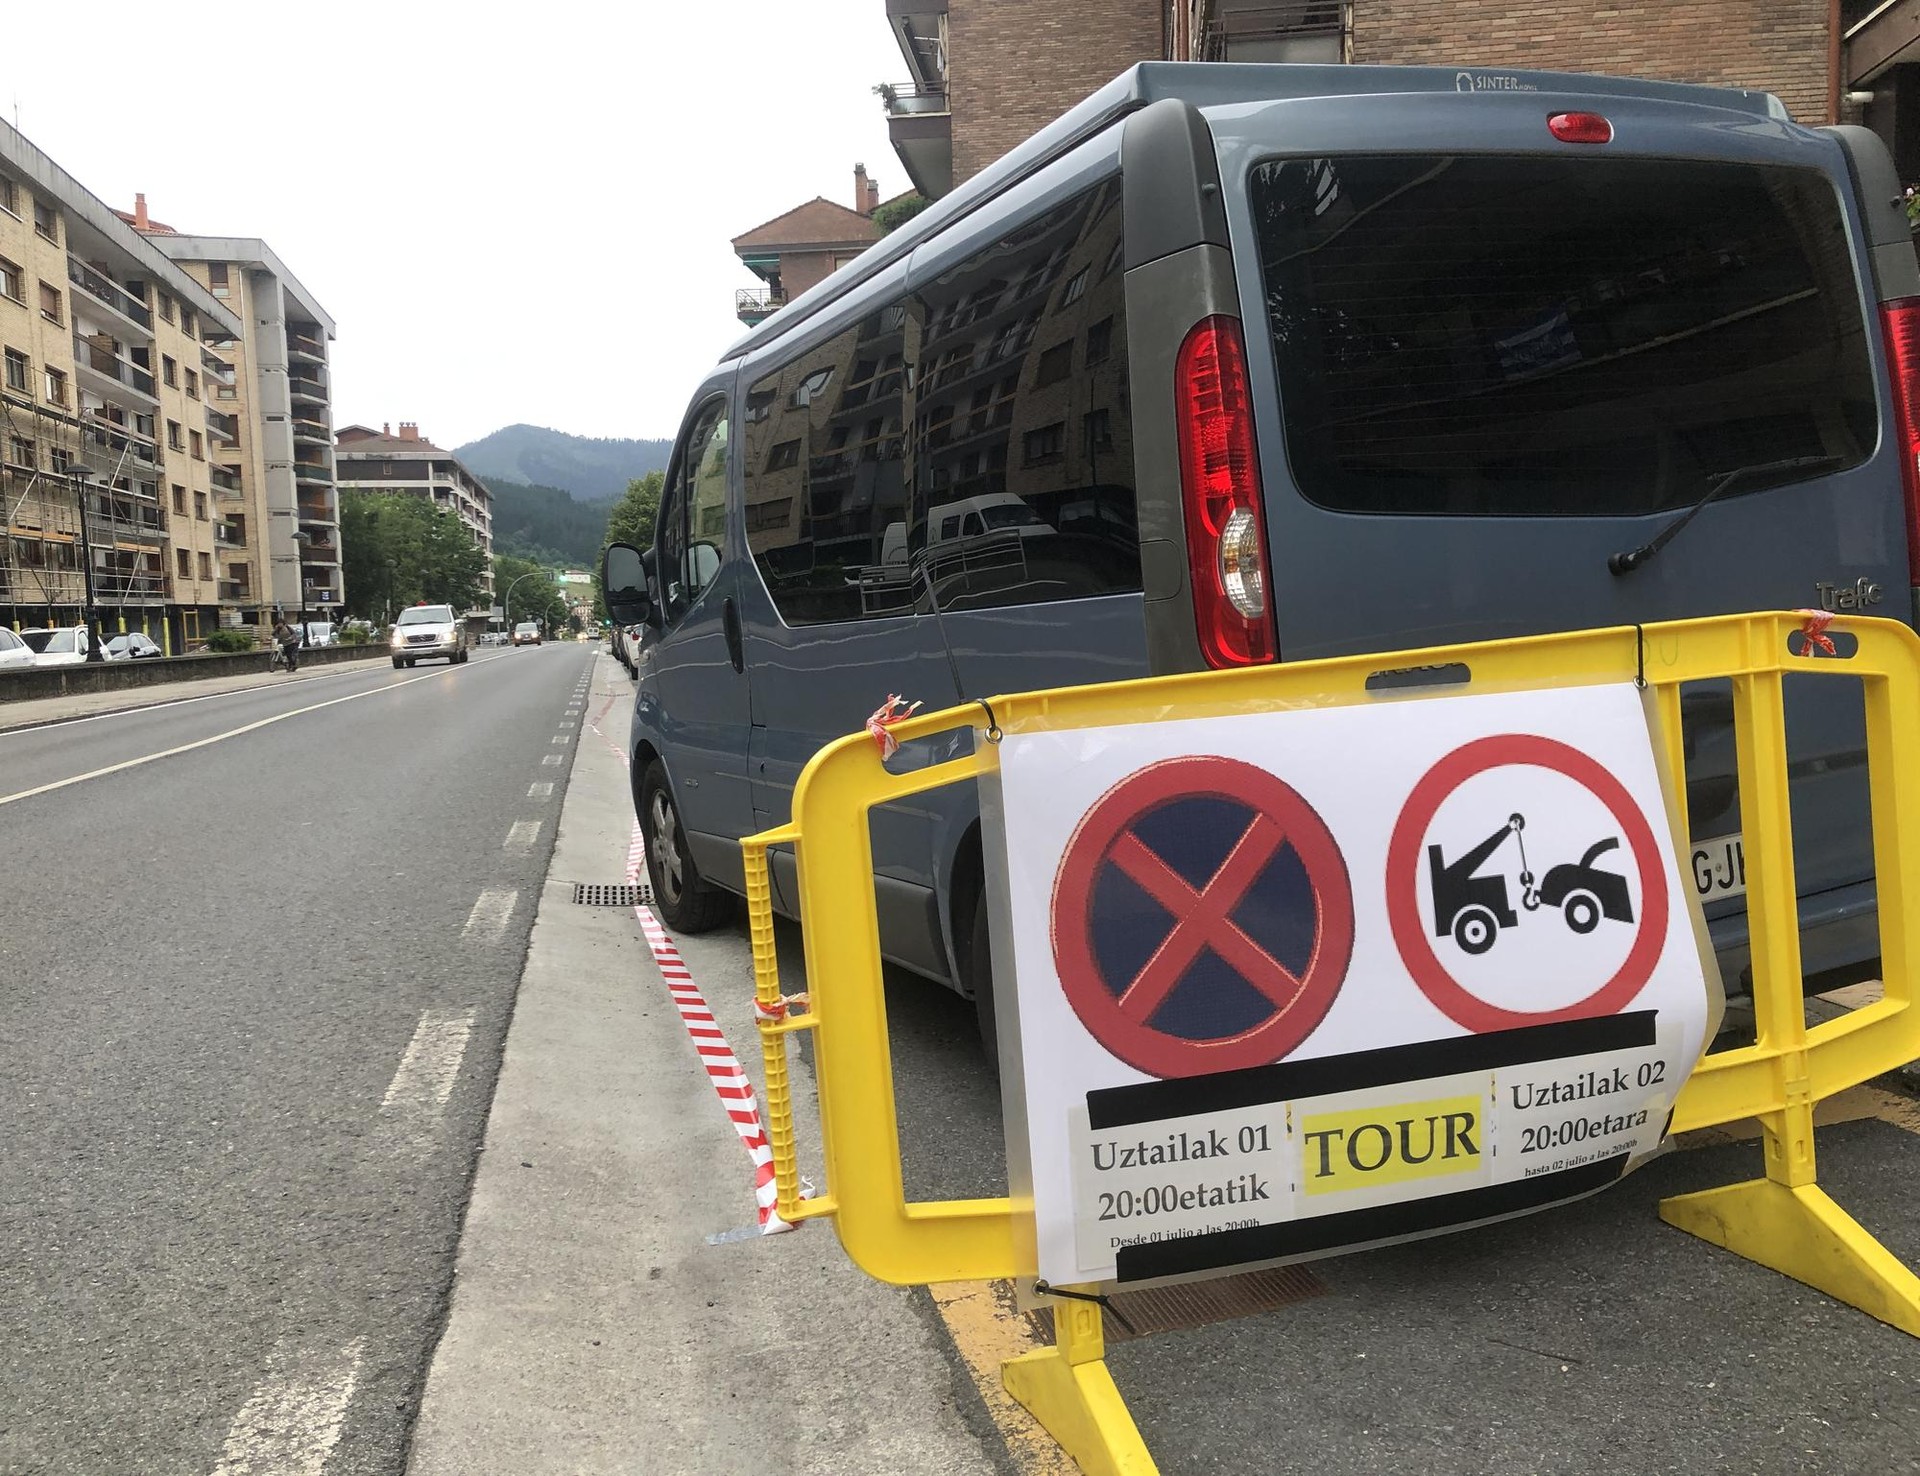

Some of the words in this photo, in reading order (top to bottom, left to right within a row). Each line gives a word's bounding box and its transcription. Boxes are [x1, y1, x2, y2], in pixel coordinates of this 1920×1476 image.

[1476, 76, 1518, 90] SINTER
[1816, 577, 1883, 611] Trafic
[1511, 1067, 1629, 1110] Uztailak
[1637, 1060, 1666, 1087] 02
[1090, 1129, 1230, 1171] Uztailak
[1238, 1124, 1272, 1154] 01
[1304, 1111, 1480, 1178] TOUR
[1520, 1109, 1648, 1154] 20:00etara
[1525, 1165, 1550, 1177] hasta
[1552, 1161, 1563, 1171] 02
[1565, 1155, 1588, 1169] julio
[1597, 1150, 1610, 1159] las
[1098, 1173, 1270, 1221] 20:00etatik
[1110, 1234, 1148, 1248] Desde
[1150, 1232, 1163, 1243] 01
[1197, 1228, 1203, 1236] a
[1206, 1224, 1222, 1235] las
[1225, 1218, 1260, 1232] 20:00h
